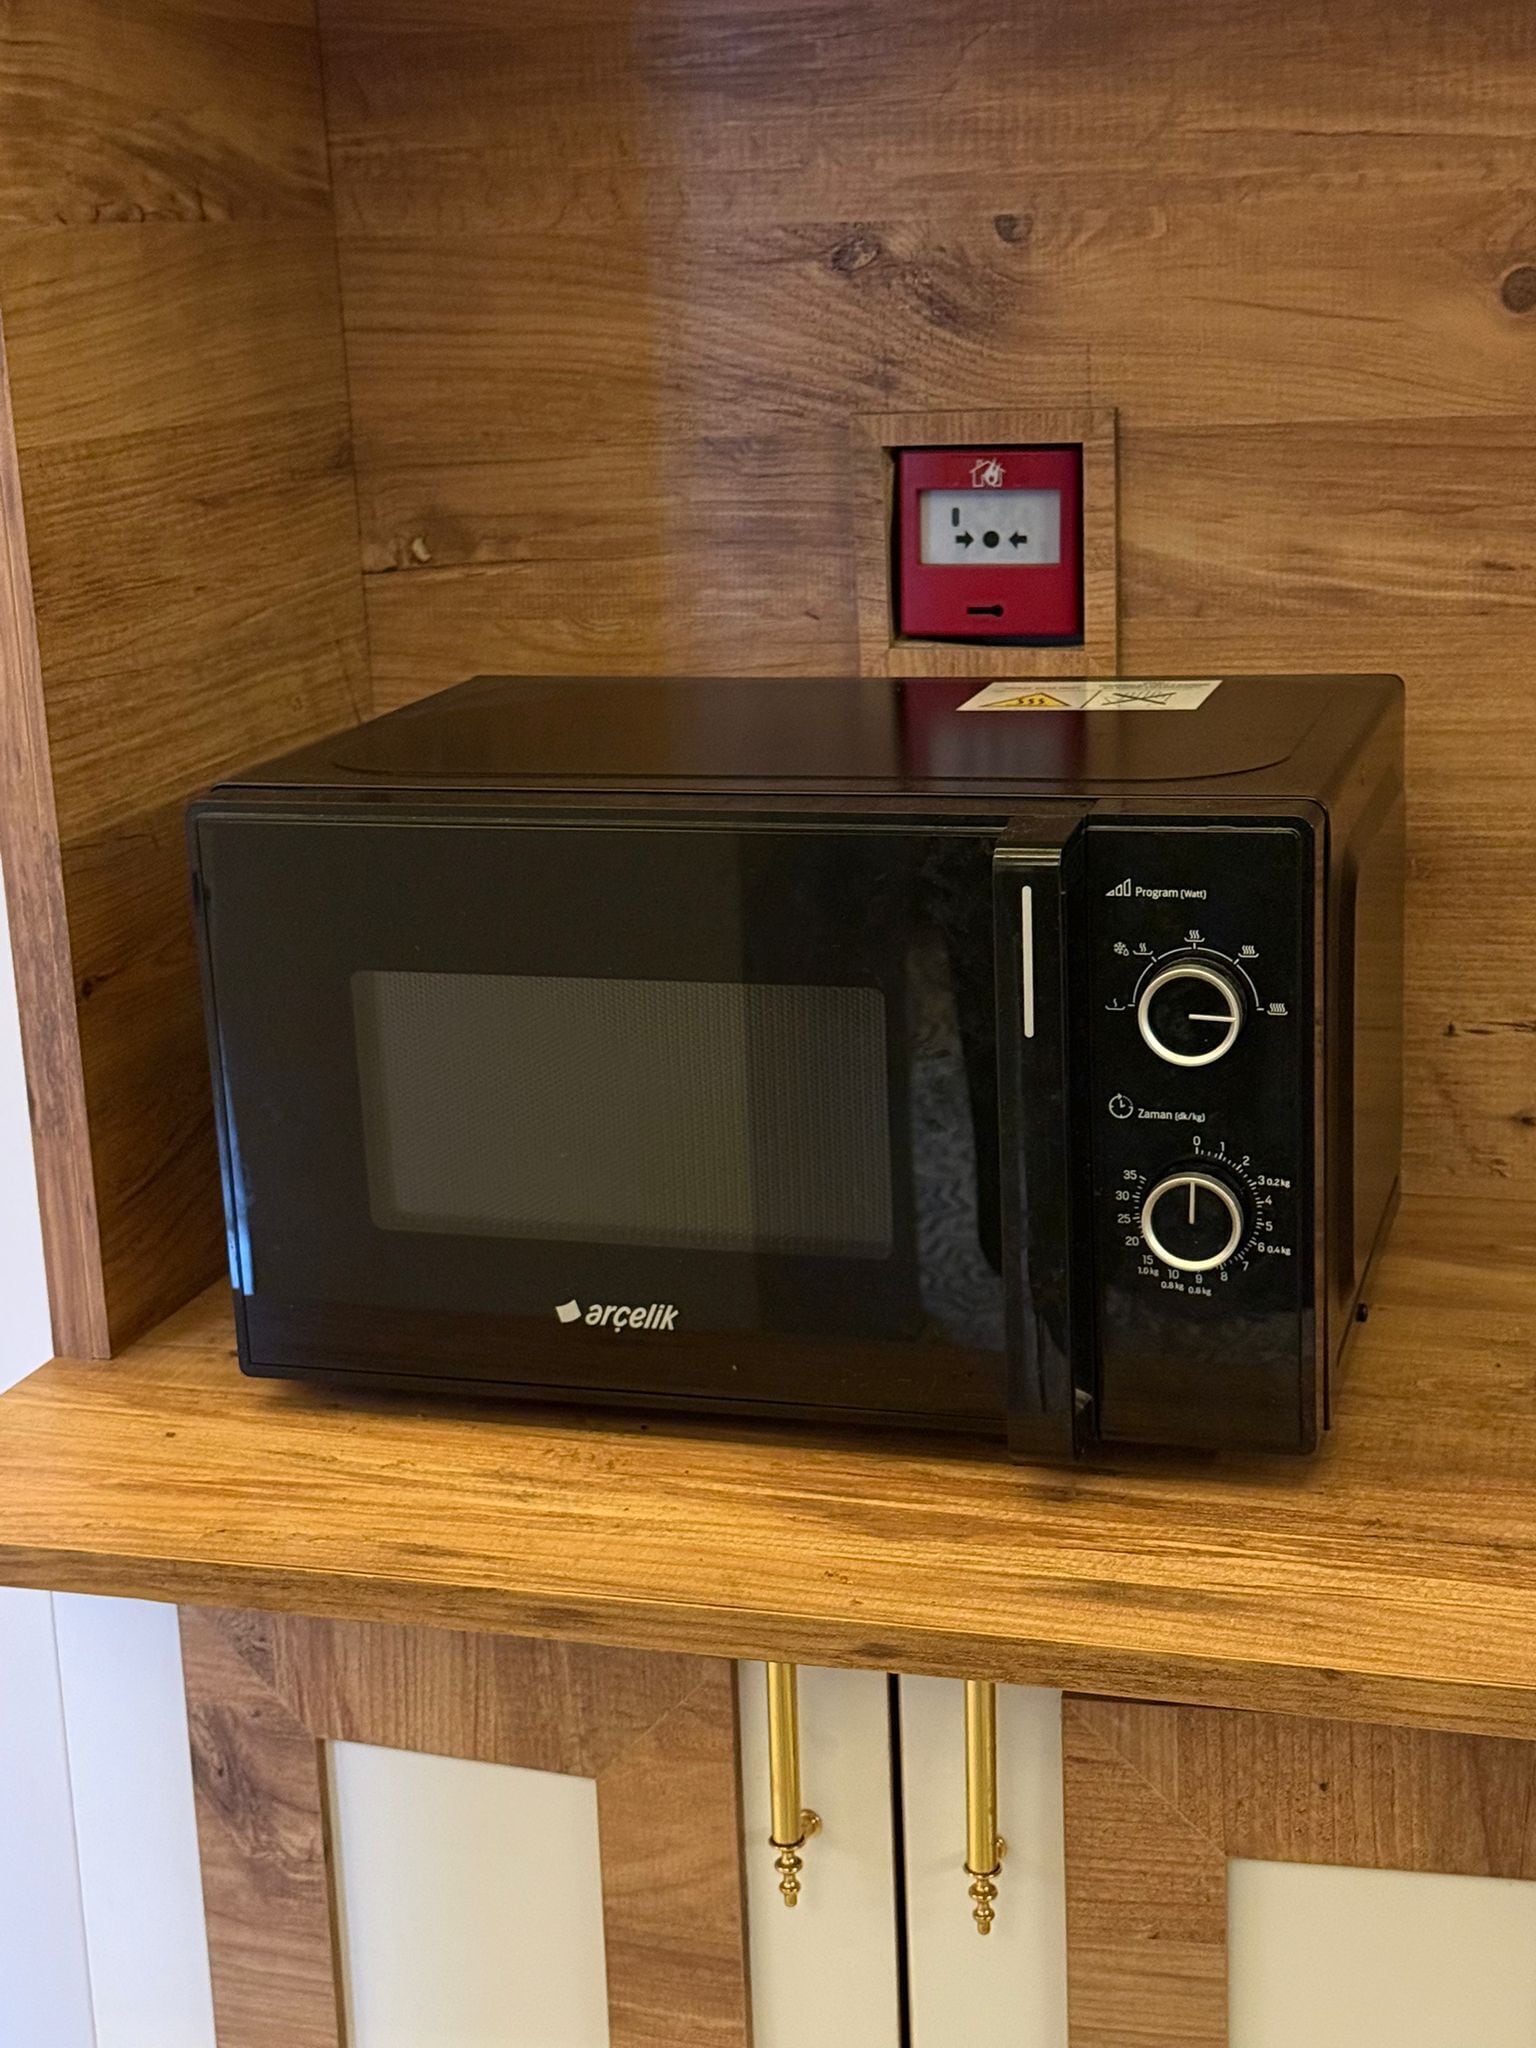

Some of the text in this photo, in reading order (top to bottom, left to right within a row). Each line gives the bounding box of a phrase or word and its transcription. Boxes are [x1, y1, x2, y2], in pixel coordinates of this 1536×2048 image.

[1135, 886, 1207, 900] Program (Watt)
[1137, 1108, 1206, 1123] Zaman (dk/kg)
[1192, 1135, 1201, 1146] 0
[1219, 1141, 1225, 1152] 1
[1242, 1155, 1250, 1167] 2
[1123, 1169, 1138, 1180] 35
[1257, 1175, 1291, 1189] 3 0.2 kg
[1115, 1190, 1130, 1201] 30
[1264, 1195, 1273, 1206] 4
[1117, 1213, 1132, 1224] 25
[1265, 1220, 1273, 1231] 5
[1125, 1235, 1140, 1246] 20
[1257, 1242, 1265, 1252] 6
[1280, 1246, 1291, 1257] kg
[1142, 1254, 1154, 1265] 15
[1149, 1267, 1159, 1277] kg
[1242, 1261, 1250, 1272] 7
[1167, 1269, 1180, 1280] 10
[1195, 1273, 1203, 1284] 9
[1220, 1271, 1229, 1282] 8
[1174, 1281, 1185, 1292] kg
[1201, 1286, 1212, 1297] kg
[585, 1303, 679, 1333] arçelik
